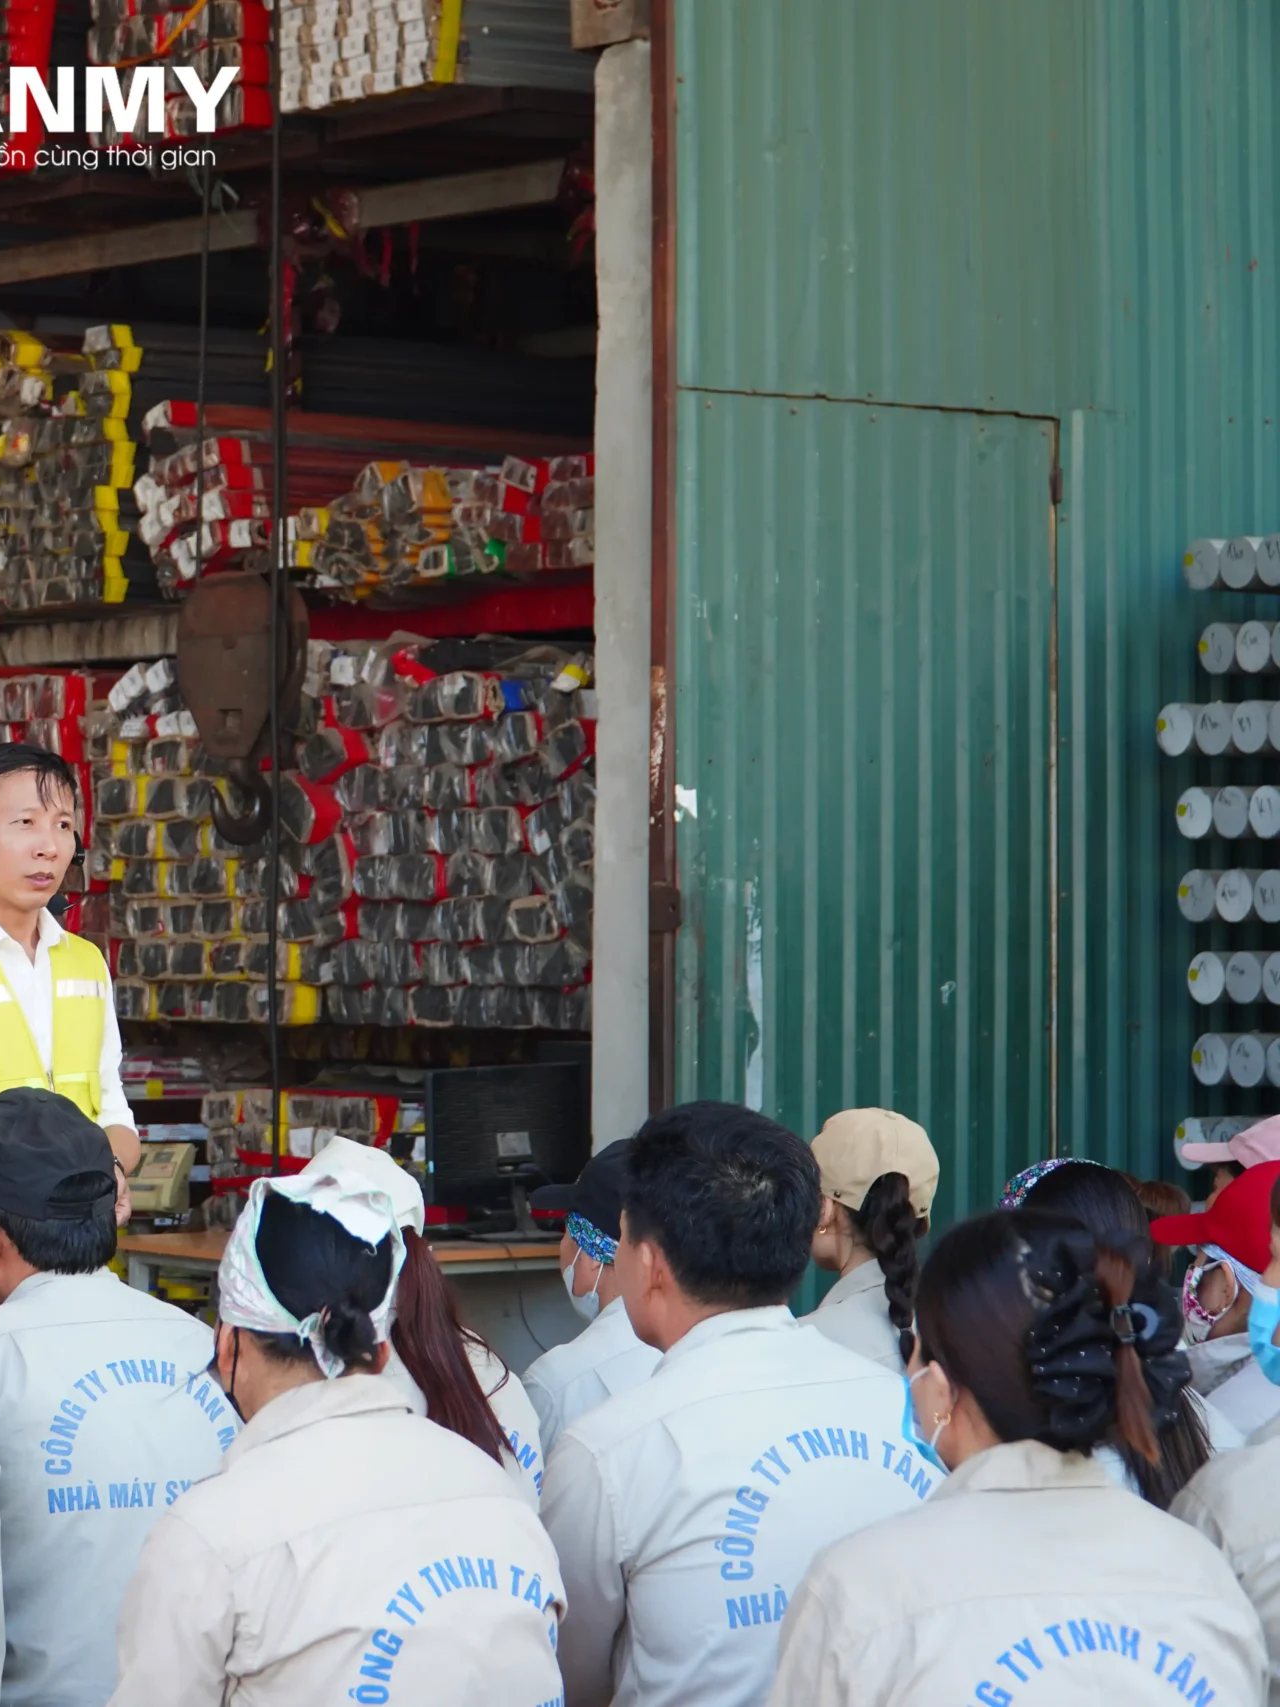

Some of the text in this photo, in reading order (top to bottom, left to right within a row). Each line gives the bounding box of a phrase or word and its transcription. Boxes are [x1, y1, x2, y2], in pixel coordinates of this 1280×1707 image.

[40, 1398, 87, 1476] CÔNG
[73, 1369, 108, 1402] TY
[106, 1358, 176, 1386] TNHH
[185, 1370, 226, 1423] TÂN
[47, 1479, 101, 1514] NHÀ
[108, 1476, 157, 1509] MÁY
[714, 1427, 933, 1581] CÔNG TY TNHH TÂN
[348, 1627, 404, 1706] ÔNG
[386, 1582, 425, 1625] TY
[419, 1555, 498, 1597] TNHH
[725, 1583, 789, 1629] NHÀ
[995, 1617, 1216, 1707] TY TNHH TÂN
